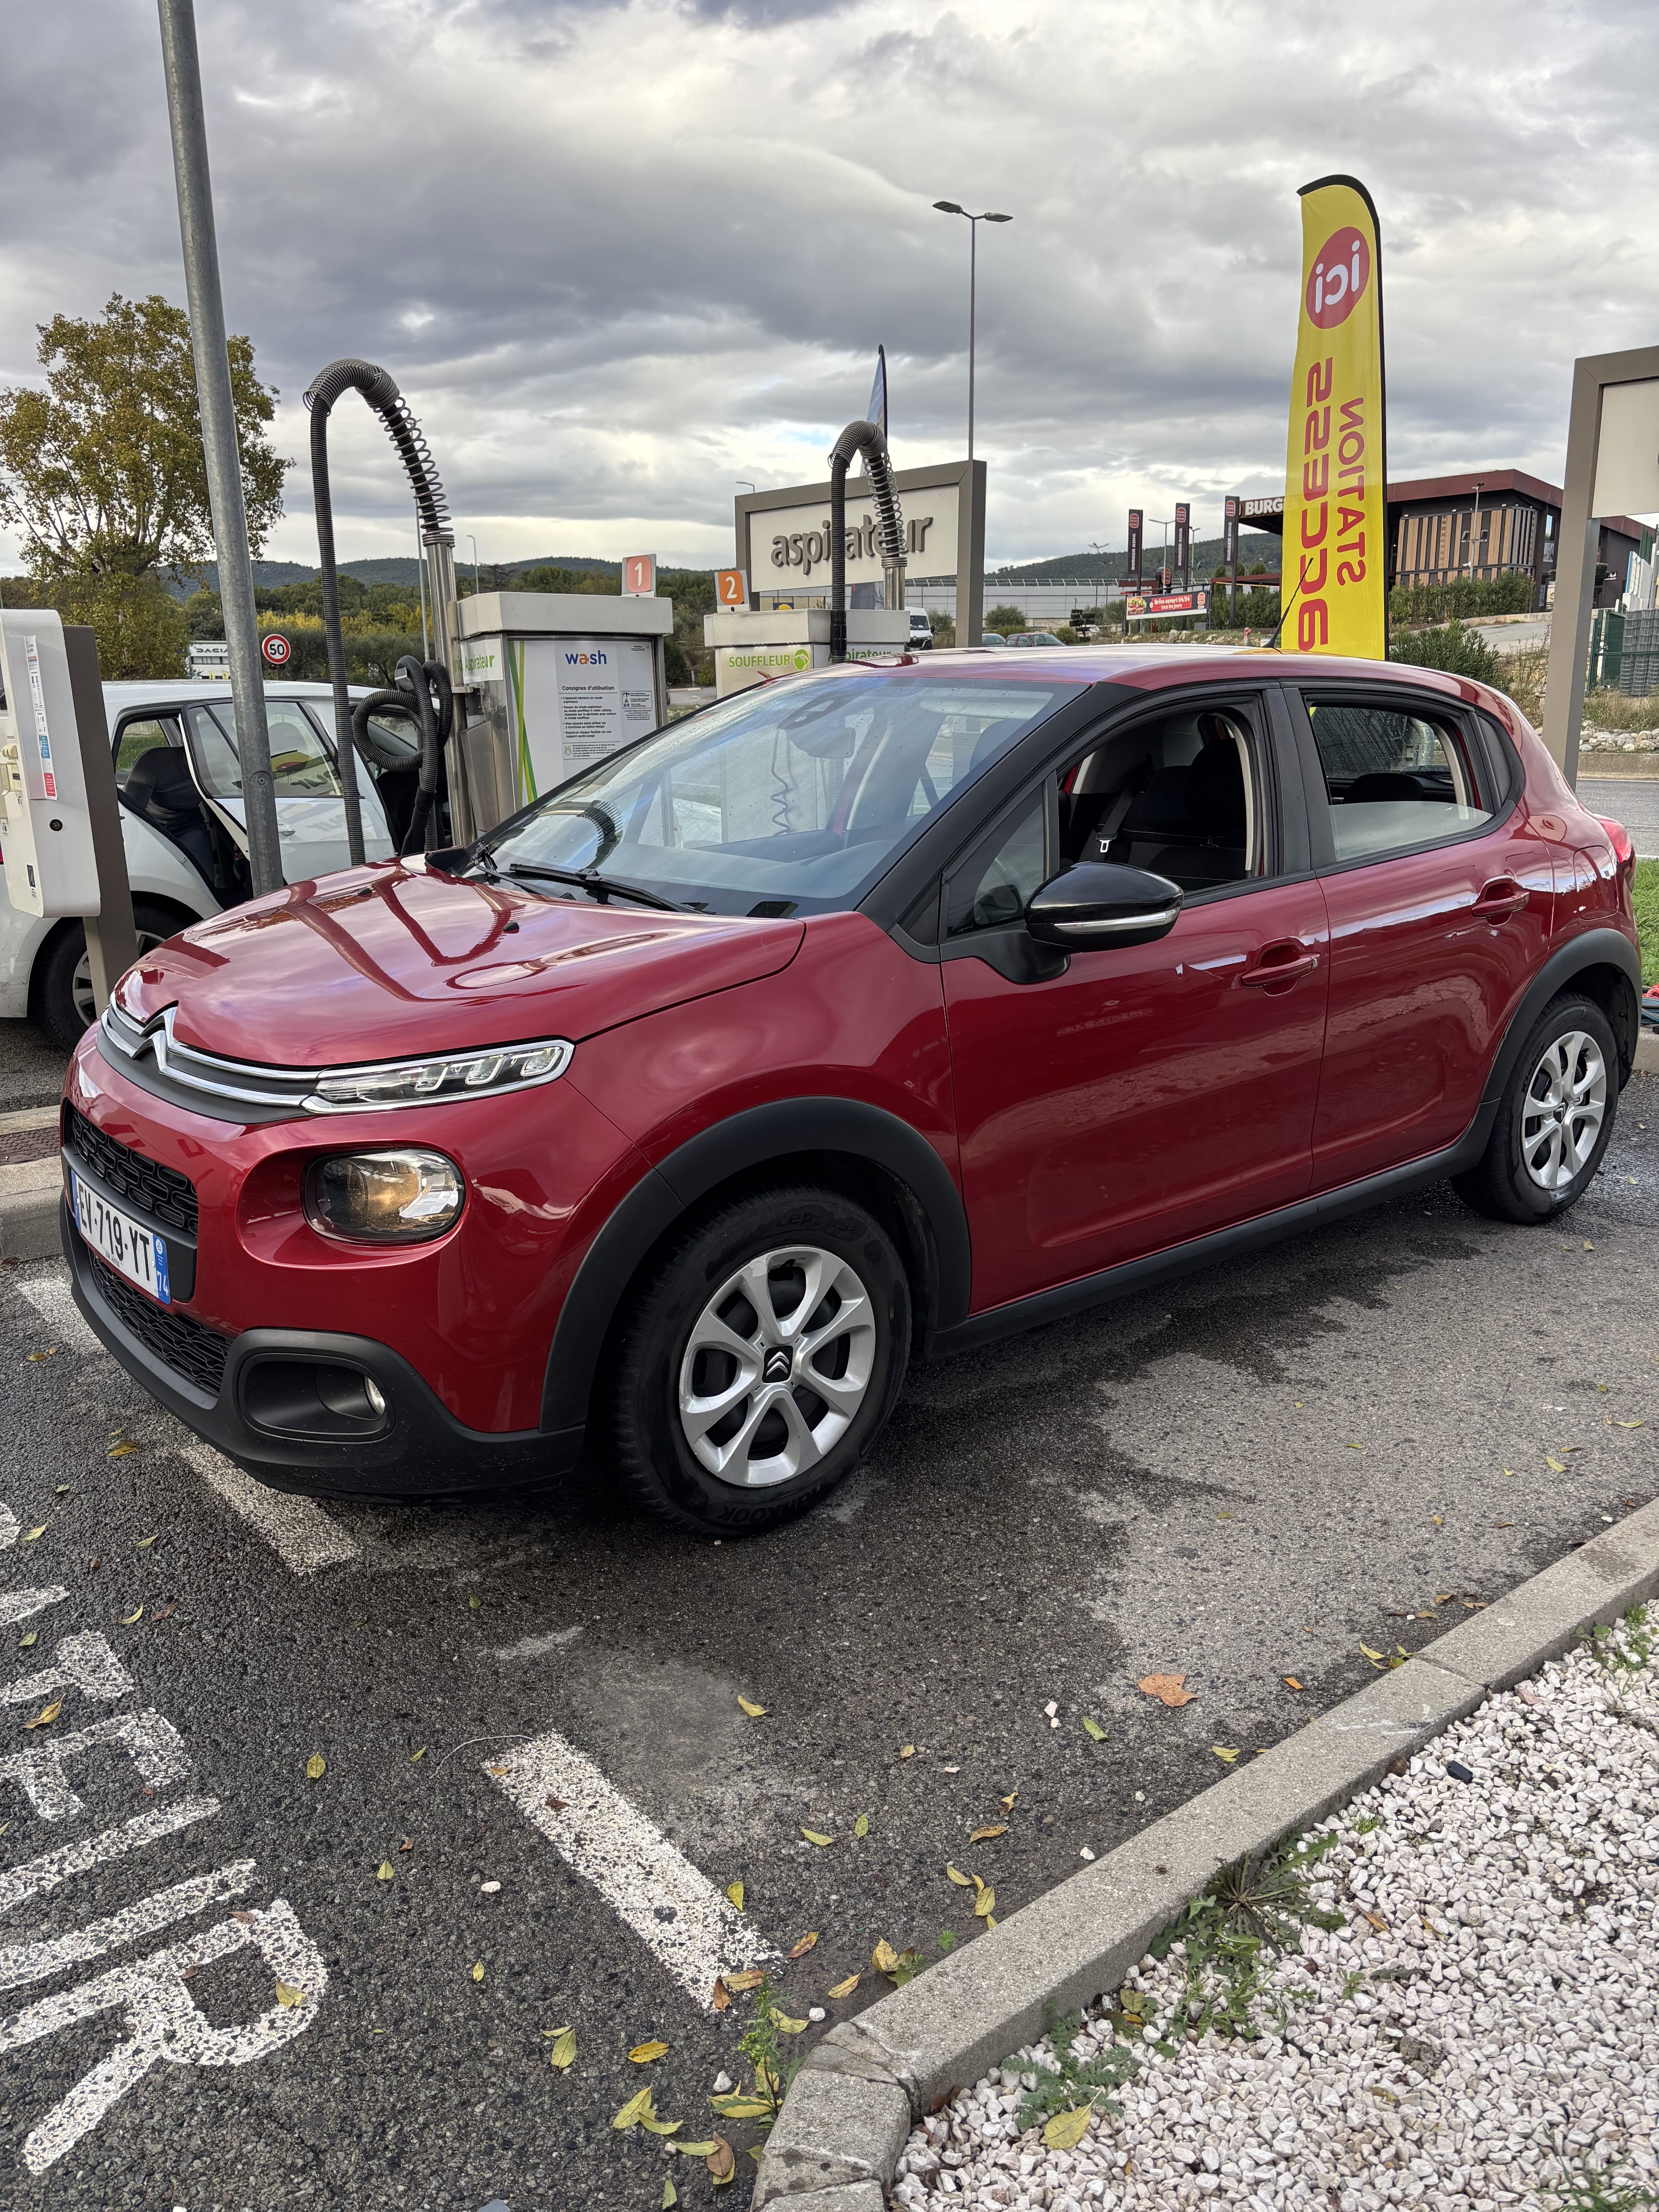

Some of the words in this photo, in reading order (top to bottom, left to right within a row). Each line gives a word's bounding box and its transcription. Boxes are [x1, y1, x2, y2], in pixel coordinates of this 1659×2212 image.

[1245, 498, 1283, 515] BURG
[634, 563, 642, 586] 1
[726, 576, 737, 599] 2
[270, 644, 285, 655] 50
[565, 650, 607, 665] wash
[465, 654, 495, 673] Aspirateur
[729, 655, 790, 668] SOUFFLEUR
[157, 1271, 169, 1296] 74
